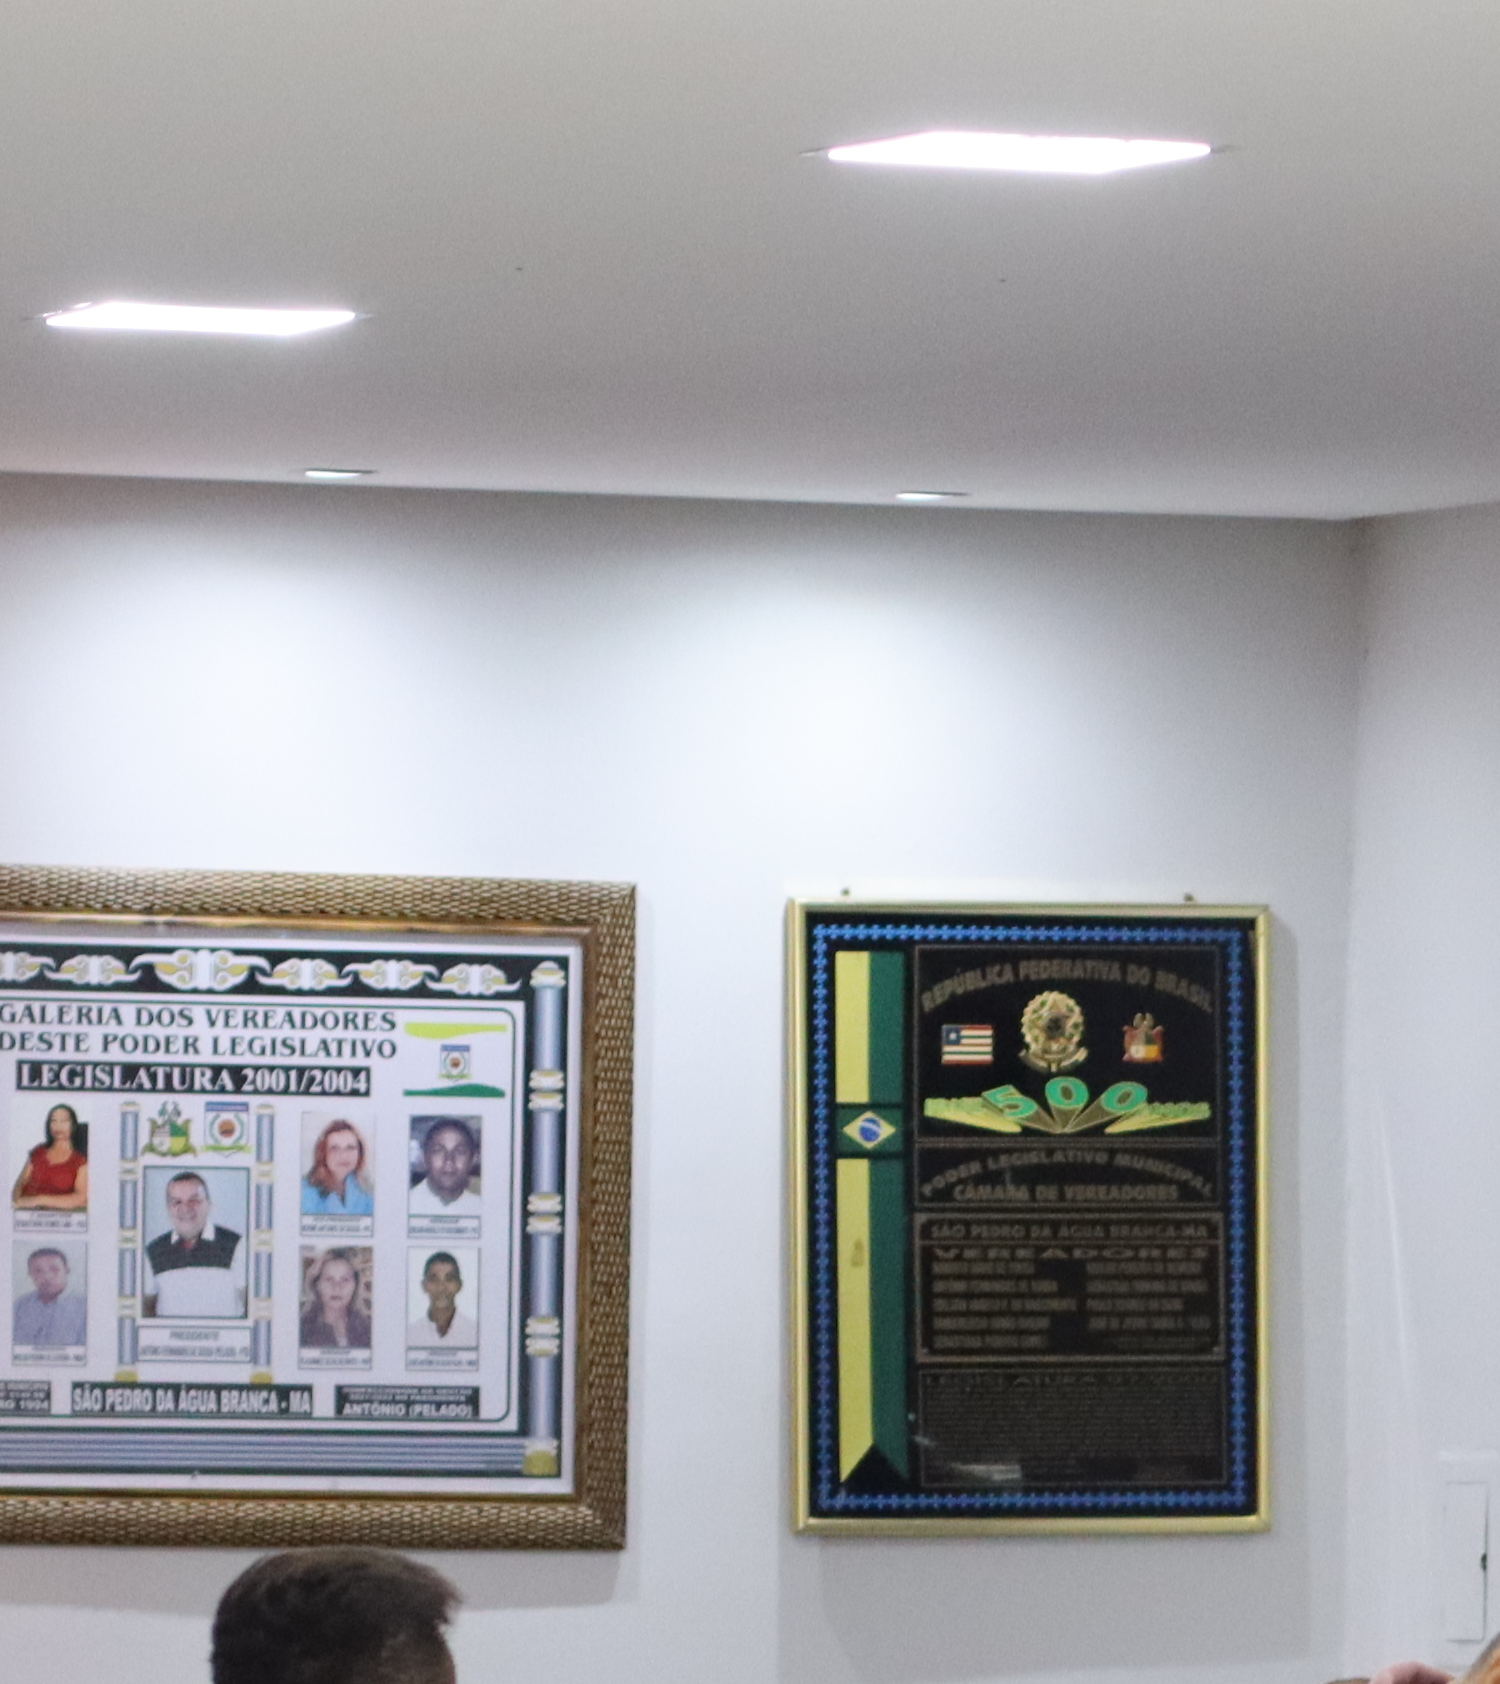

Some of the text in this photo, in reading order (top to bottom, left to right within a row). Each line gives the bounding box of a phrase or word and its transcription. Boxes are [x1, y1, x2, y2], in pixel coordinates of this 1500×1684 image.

[1019, 958, 1121, 981] FEDERATIVA
[1127, 962, 1150, 985] DO
[1154, 969, 1212, 1013] BRASIL
[134, 1006, 194, 1028] DOS
[205, 1008, 397, 1032] VEREADORES
[101, 1033, 200, 1055] PODER
[211, 1035, 398, 1059] LEGISLATIVO
[20, 1063, 370, 1095] LEGISLATURA 2001/2004
[981, 1076, 1149, 1118] 500
[986, 1150, 1109, 1171] LEGISLATIVO
[1113, 1153, 1213, 1198] MUNICIPAL
[1035, 1185, 1058, 1201] DE
[1064, 1184, 1179, 1201] VEREADORES
[971, 1224, 1027, 1239] PEDRO
[1031, 1224, 1053, 1239] DA
[932, 1247, 1209, 1259] VEREADORES
[71, 1383, 100, 1412] SÃO
[104, 1388, 151, 1413] PEDRO
[156, 1389, 175, 1413] DA
[180, 1383, 217, 1413] ÁGUA
[220, 1389, 279, 1414] BRANCA
[289, 1391, 311, 1414] MA
